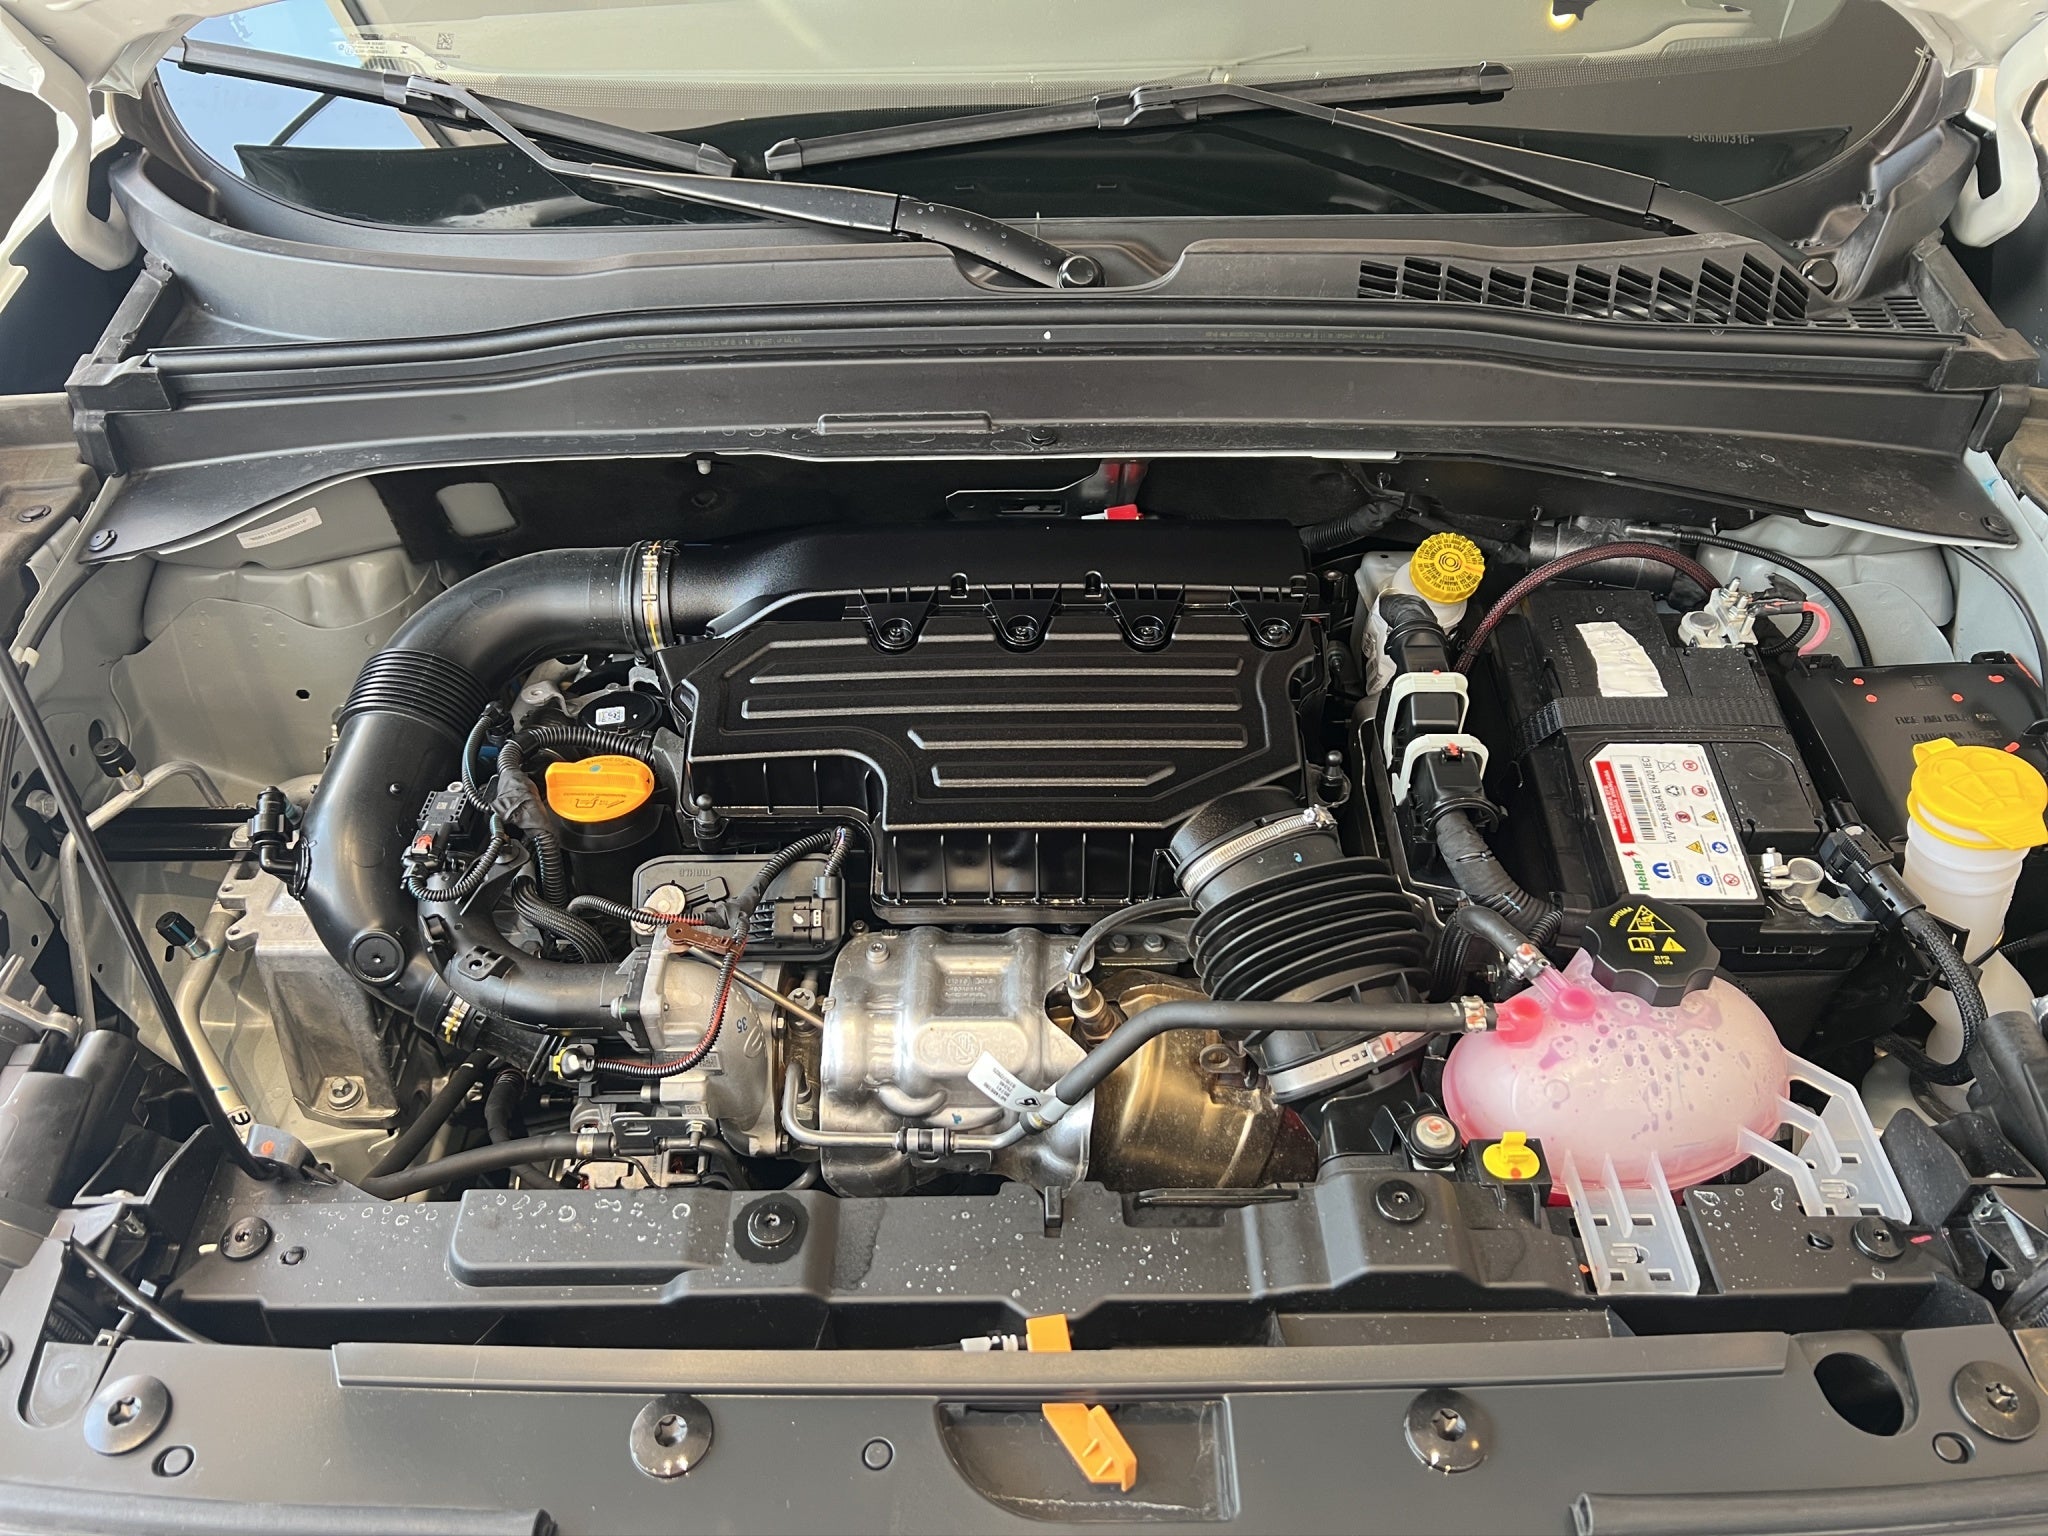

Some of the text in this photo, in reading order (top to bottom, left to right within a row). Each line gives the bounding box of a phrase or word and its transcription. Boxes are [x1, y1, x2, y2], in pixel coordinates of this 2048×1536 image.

[1650, 785, 1661, 794] EN
[1661, 813, 1673, 830] 72Ah
[1665, 830, 1677, 843] 12V
[1631, 857, 1651, 891] Heliar
[736, 1016, 748, 1034] 35
